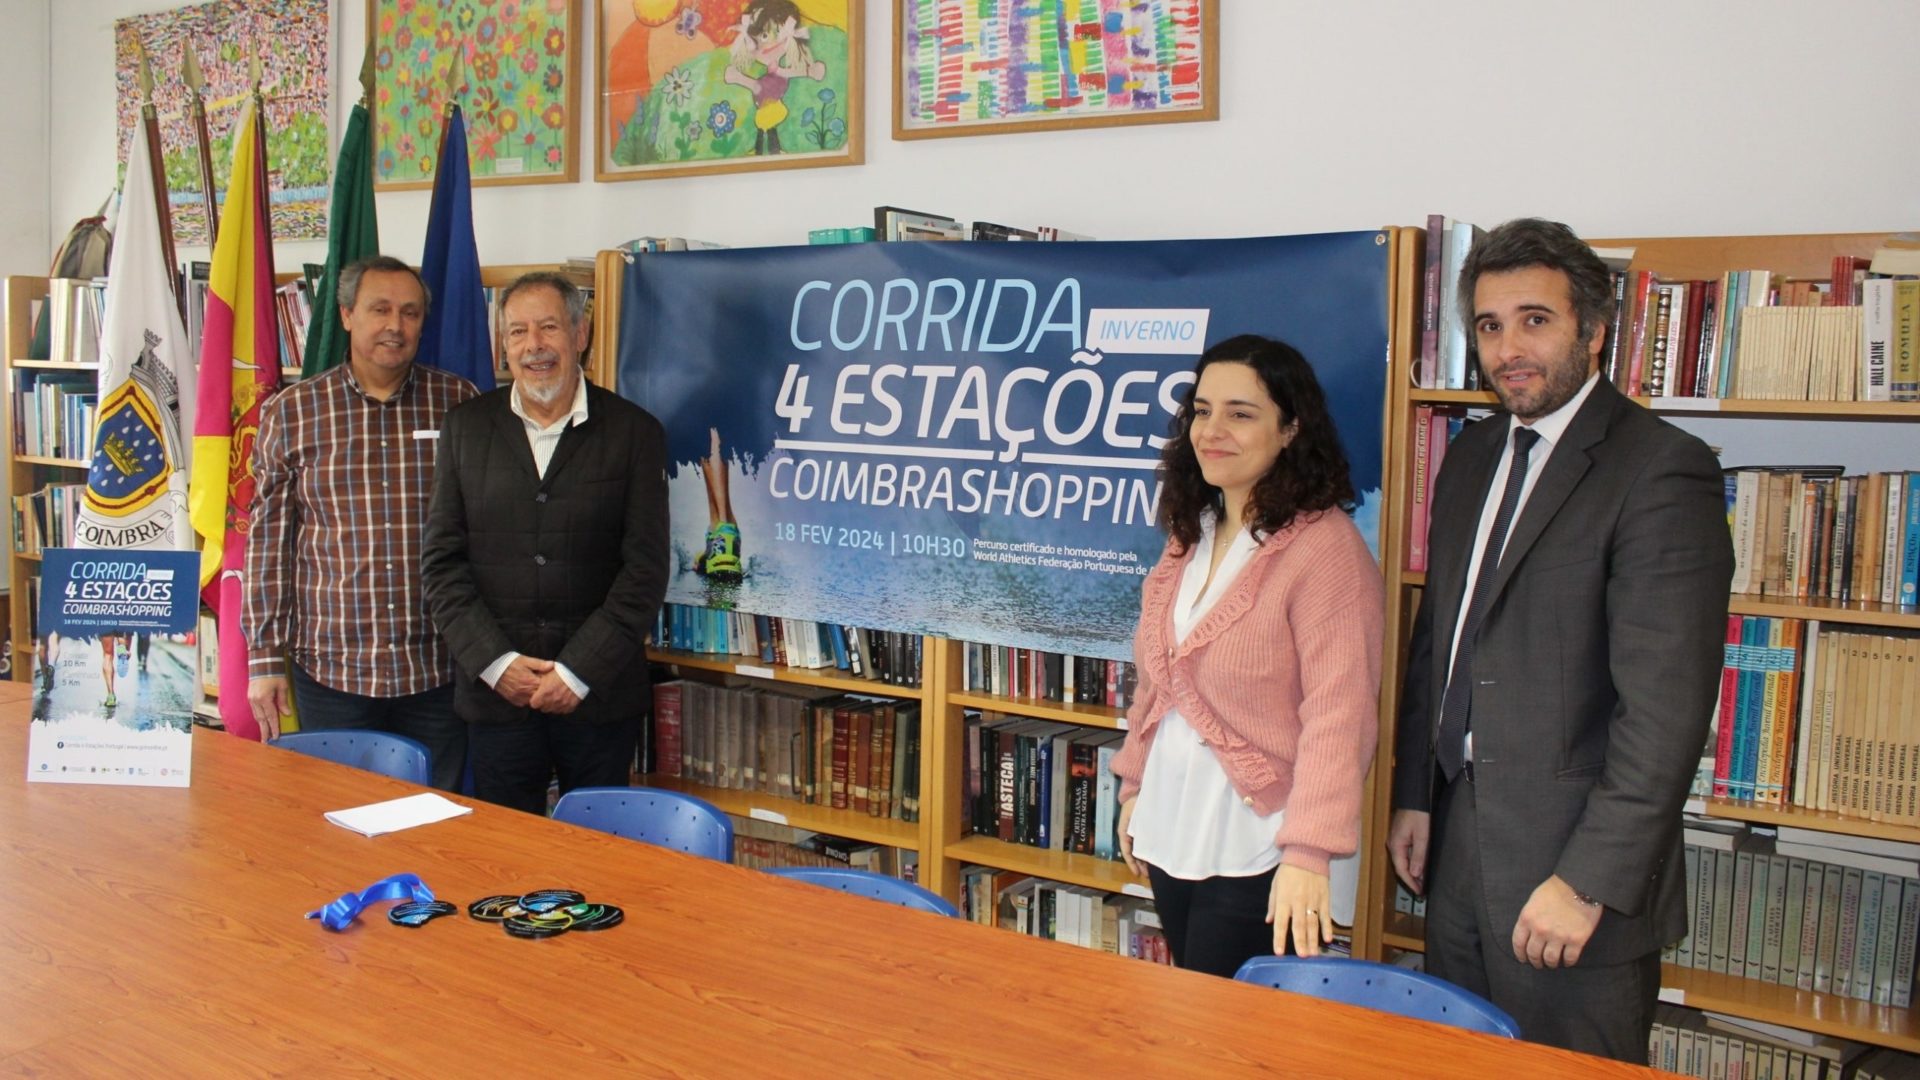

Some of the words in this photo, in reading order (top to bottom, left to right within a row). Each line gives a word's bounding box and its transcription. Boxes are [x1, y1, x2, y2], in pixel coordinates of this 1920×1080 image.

[790, 278, 1082, 353] CORRIDA
[1100, 319, 1195, 342] INVERNO
[1870, 340, 1885, 365] CAINE
[1870, 367, 1884, 386] HALL
[774, 364, 813, 433] 4
[830, 348, 1197, 462] ESTAÇÕES
[769, 457, 1164, 527] COIMBRASHOPPIN
[1415, 458, 1425, 504] Juventude
[77, 520, 164, 546] COIMBRA
[775, 522, 795, 542] 18
[801, 526, 833, 546] FEV
[838, 528, 884, 551] 2024
[902, 534, 965, 559] 10H30
[973, 538, 1009, 551] Percurso
[1010, 540, 1055, 555] certificado
[1056, 546, 1062, 555] e
[1064, 544, 1117, 561] homologado
[1119, 548, 1137, 563] pela
[71, 561, 147, 580] CORRIDA
[973, 550, 997, 562] World
[999, 551, 1037, 567] Athletics
[1038, 554, 1082, 571] Federação
[1084, 558, 1134, 576] Portuguesa
[1136, 564, 1147, 576] de
[65, 582, 77, 598] 4
[82, 579, 173, 603] ESTAÇÕES
[63, 603, 172, 617] COIMBRASHOPPING
[68, 679, 80, 687] Km
[1834, 734, 1842, 770] UNIVERSAL
[1843, 736, 1851, 772] UNIVERSAL
[1853, 738, 1862, 774] UNIVERSAL
[1864, 740, 1873, 776] UNIVERSAL
[1877, 741, 1885, 777] UNIVERSAL
[1888, 743, 1896, 780] UNIVERSAL
[1898, 744, 1907, 781] UNIVERSAL
[1910, 744, 1919, 782] UNIVERSAL
[1000, 762, 1014, 811] ASTECA
